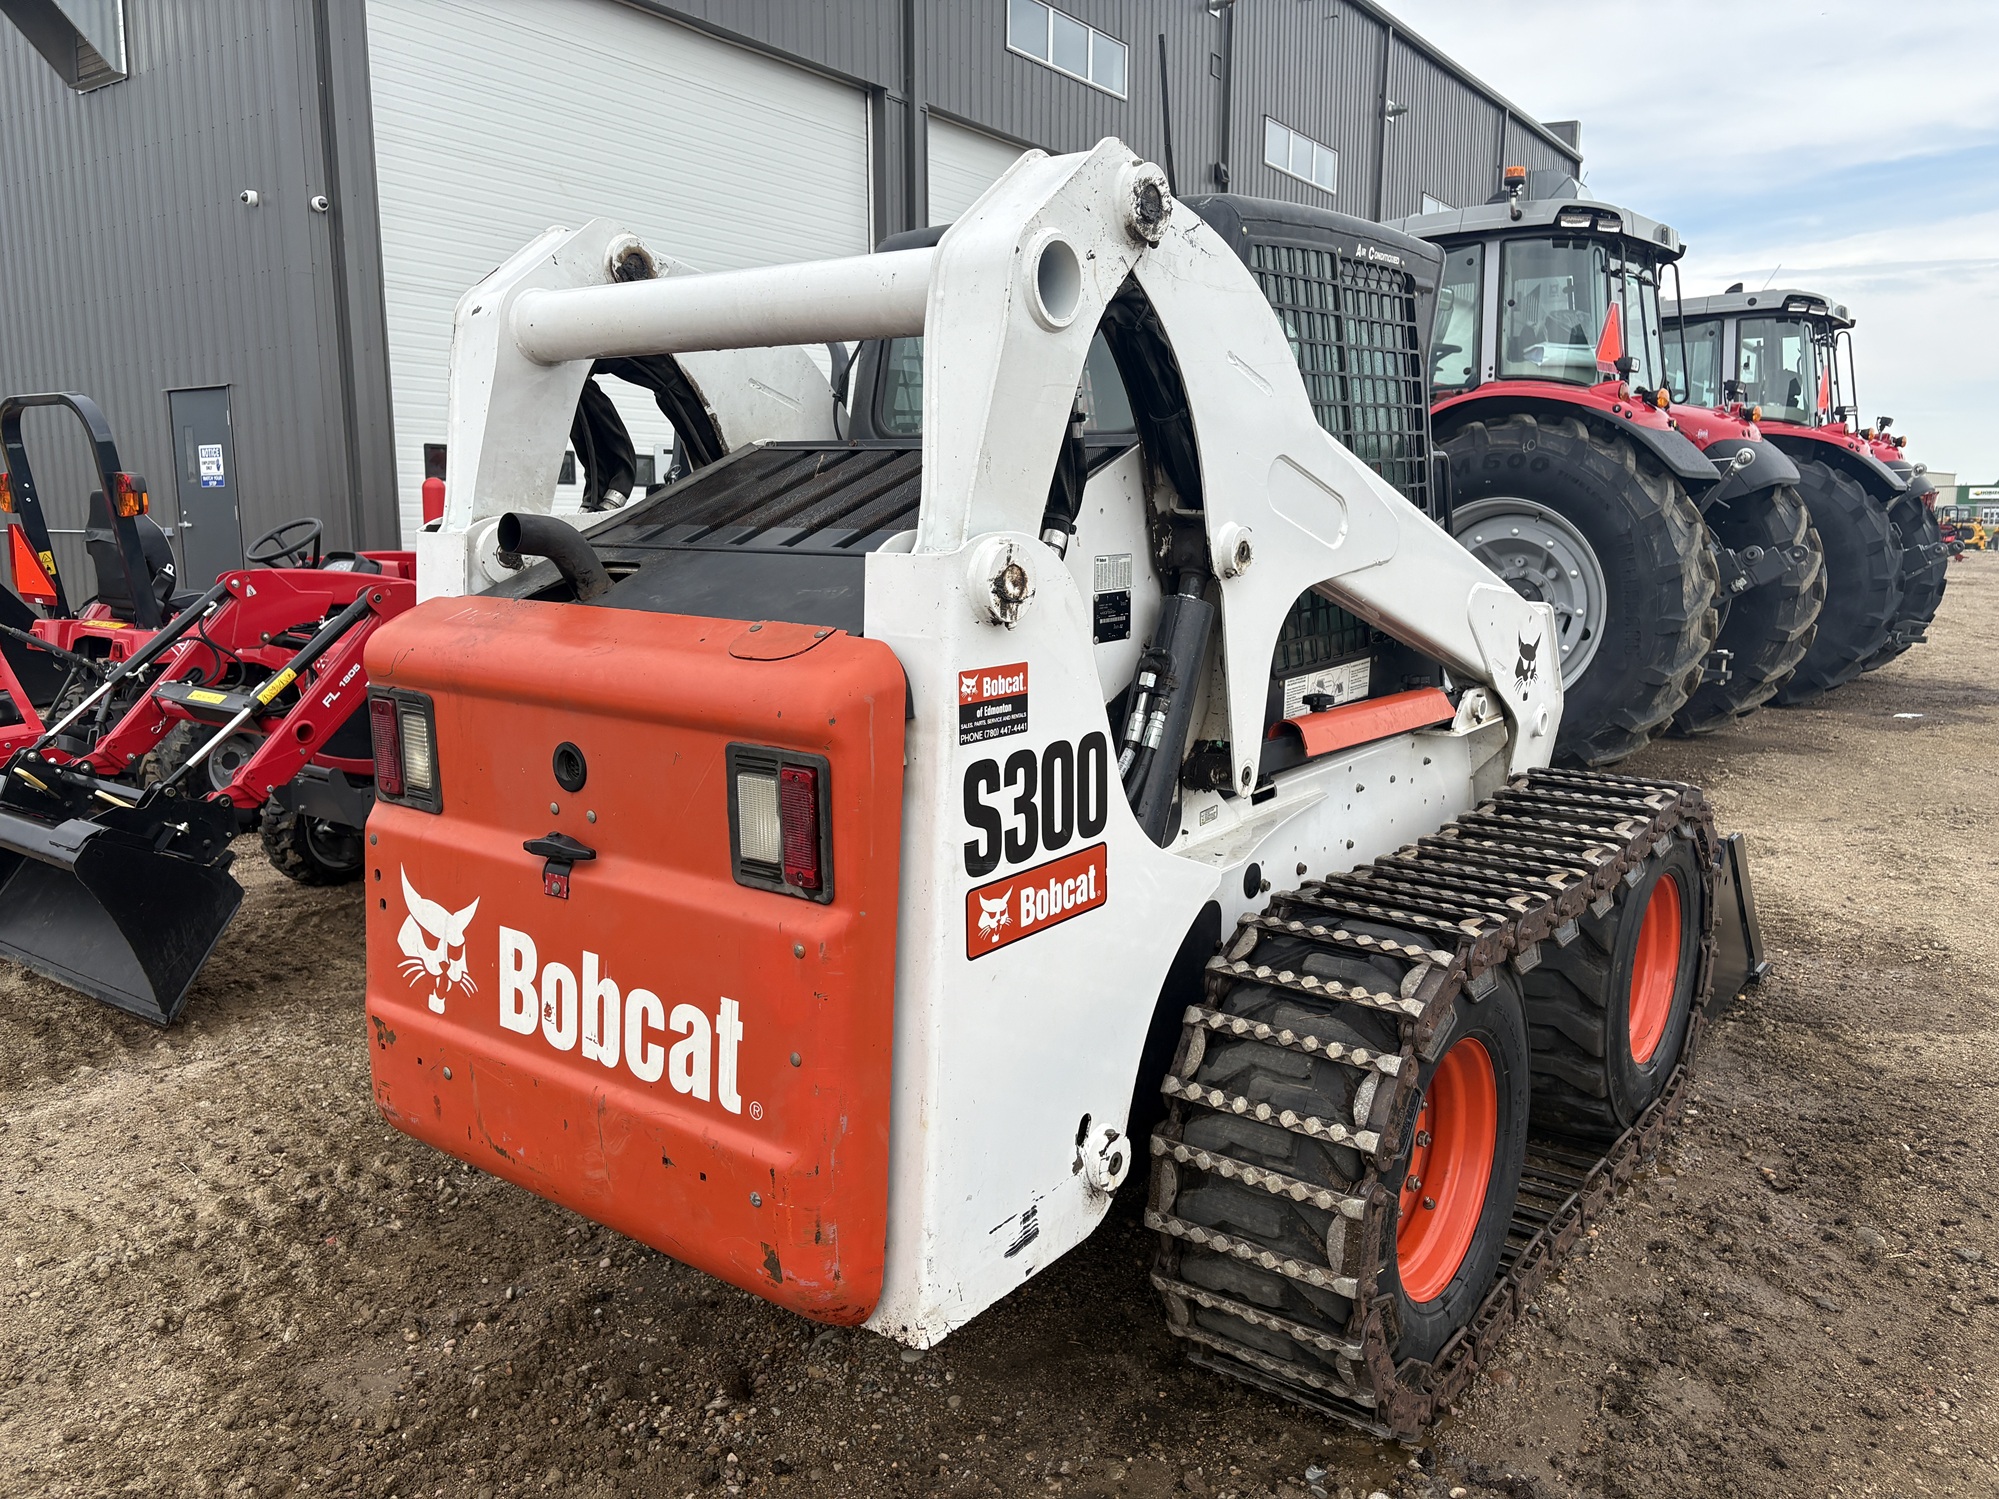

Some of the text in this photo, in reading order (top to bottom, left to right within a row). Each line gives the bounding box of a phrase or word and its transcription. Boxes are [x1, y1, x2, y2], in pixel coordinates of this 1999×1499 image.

[202, 448, 220, 457] NOTICE
[321, 662, 361, 708] FL 1805
[982, 672, 1024, 698] Bobcat
[976, 704, 1012, 718] of Edmonton
[1011, 711, 1027, 720] RENTALS
[960, 722, 1026, 744] PHONE (780) 447-4441
[963, 731, 1107, 878] S300
[1019, 864, 1096, 928] Bobcat
[499, 925, 744, 1115] Bobcat
